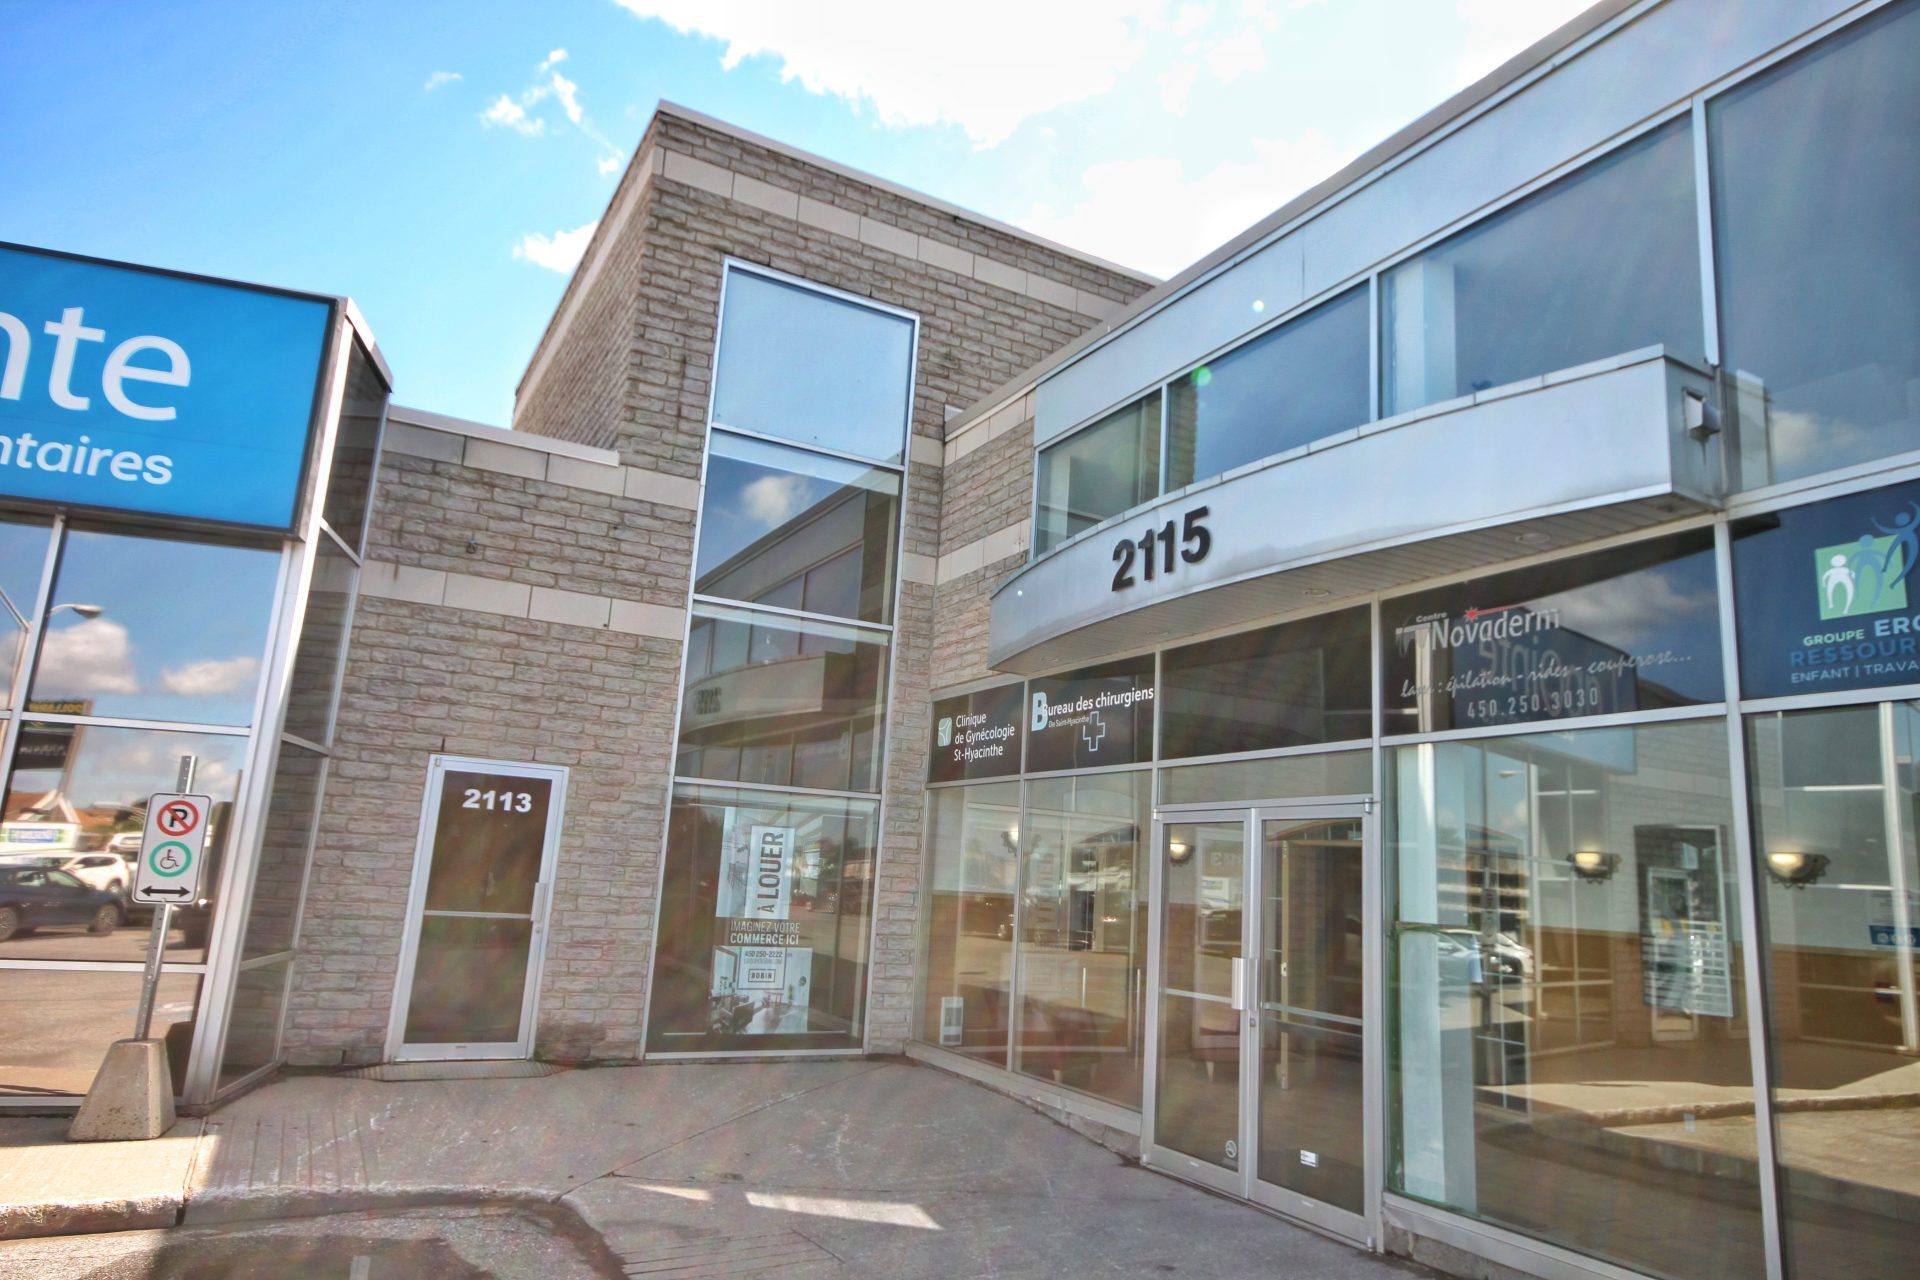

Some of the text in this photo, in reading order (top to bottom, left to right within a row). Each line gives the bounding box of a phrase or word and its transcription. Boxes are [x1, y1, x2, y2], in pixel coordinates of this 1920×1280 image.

[1111, 505, 1211, 592] 2115
[1416, 612, 1447, 623] Centre
[1432, 608, 1560, 650] Novaderm
[1802, 629, 1865, 647] GROUPE
[1790, 637, 1917, 668] RESSOUR
[1445, 669, 1512, 698] épilation
[1528, 660, 1570, 682] rides
[1791, 666, 1851, 684] ENFANT
[1863, 660, 1920, 676] TRAVA
[1075, 693, 1094, 711] des
[1095, 687, 1154, 708] chirurgiens
[1467, 687, 1599, 719] 450.250.3030
[956, 712, 987, 728] Clinique
[954, 724, 1015, 745] de Gynécologie
[953, 744, 1004, 763] St-Hyacinthe
[462, 788, 532, 812] 2113
[758, 832, 784, 900] LOUER
[730, 933, 799, 945] COMMERCE ICI
[731, 920, 800, 934] IMAGINEZ VOTRE
